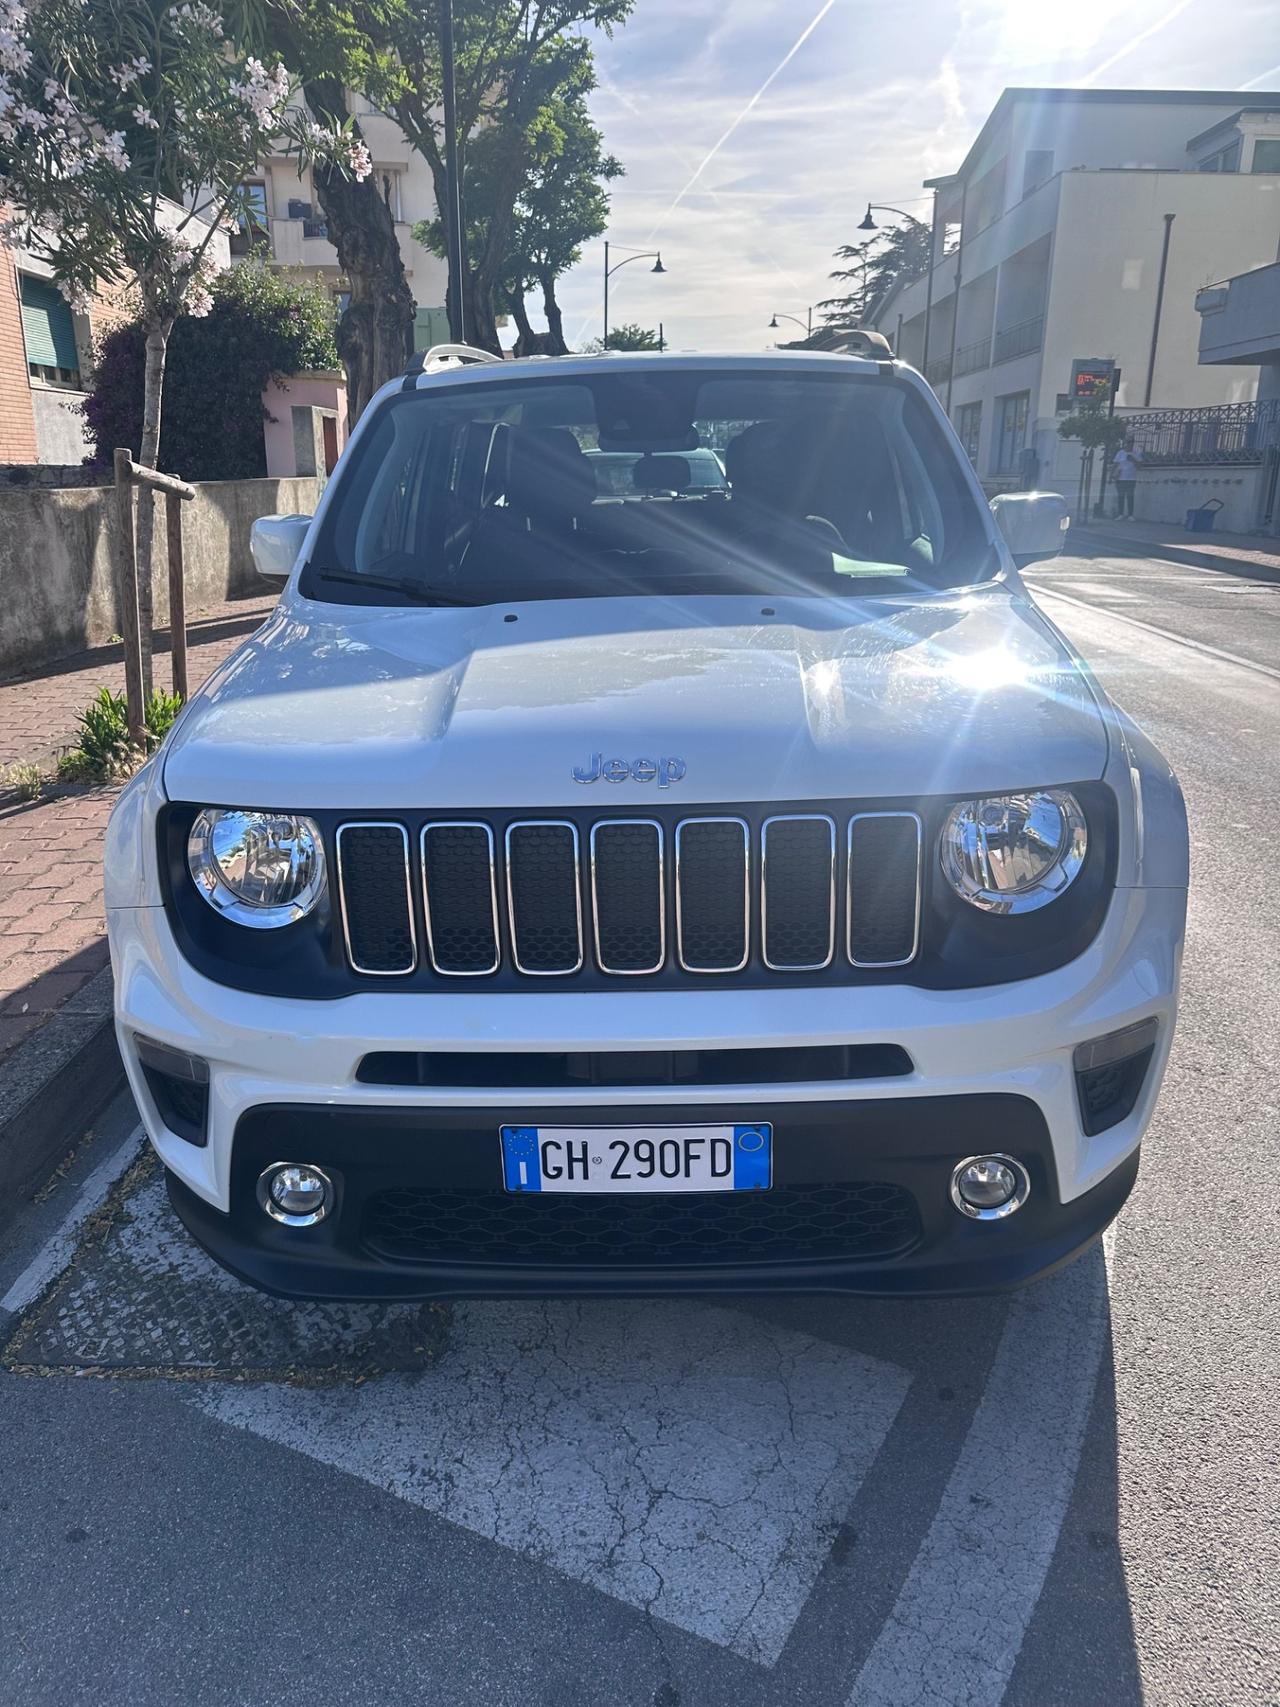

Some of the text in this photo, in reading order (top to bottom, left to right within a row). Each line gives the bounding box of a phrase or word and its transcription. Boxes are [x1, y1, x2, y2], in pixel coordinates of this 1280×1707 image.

[571, 752, 687, 789] Jeep
[519, 1161, 527, 1185] I
[541, 1138, 731, 1180] GH 290FD
